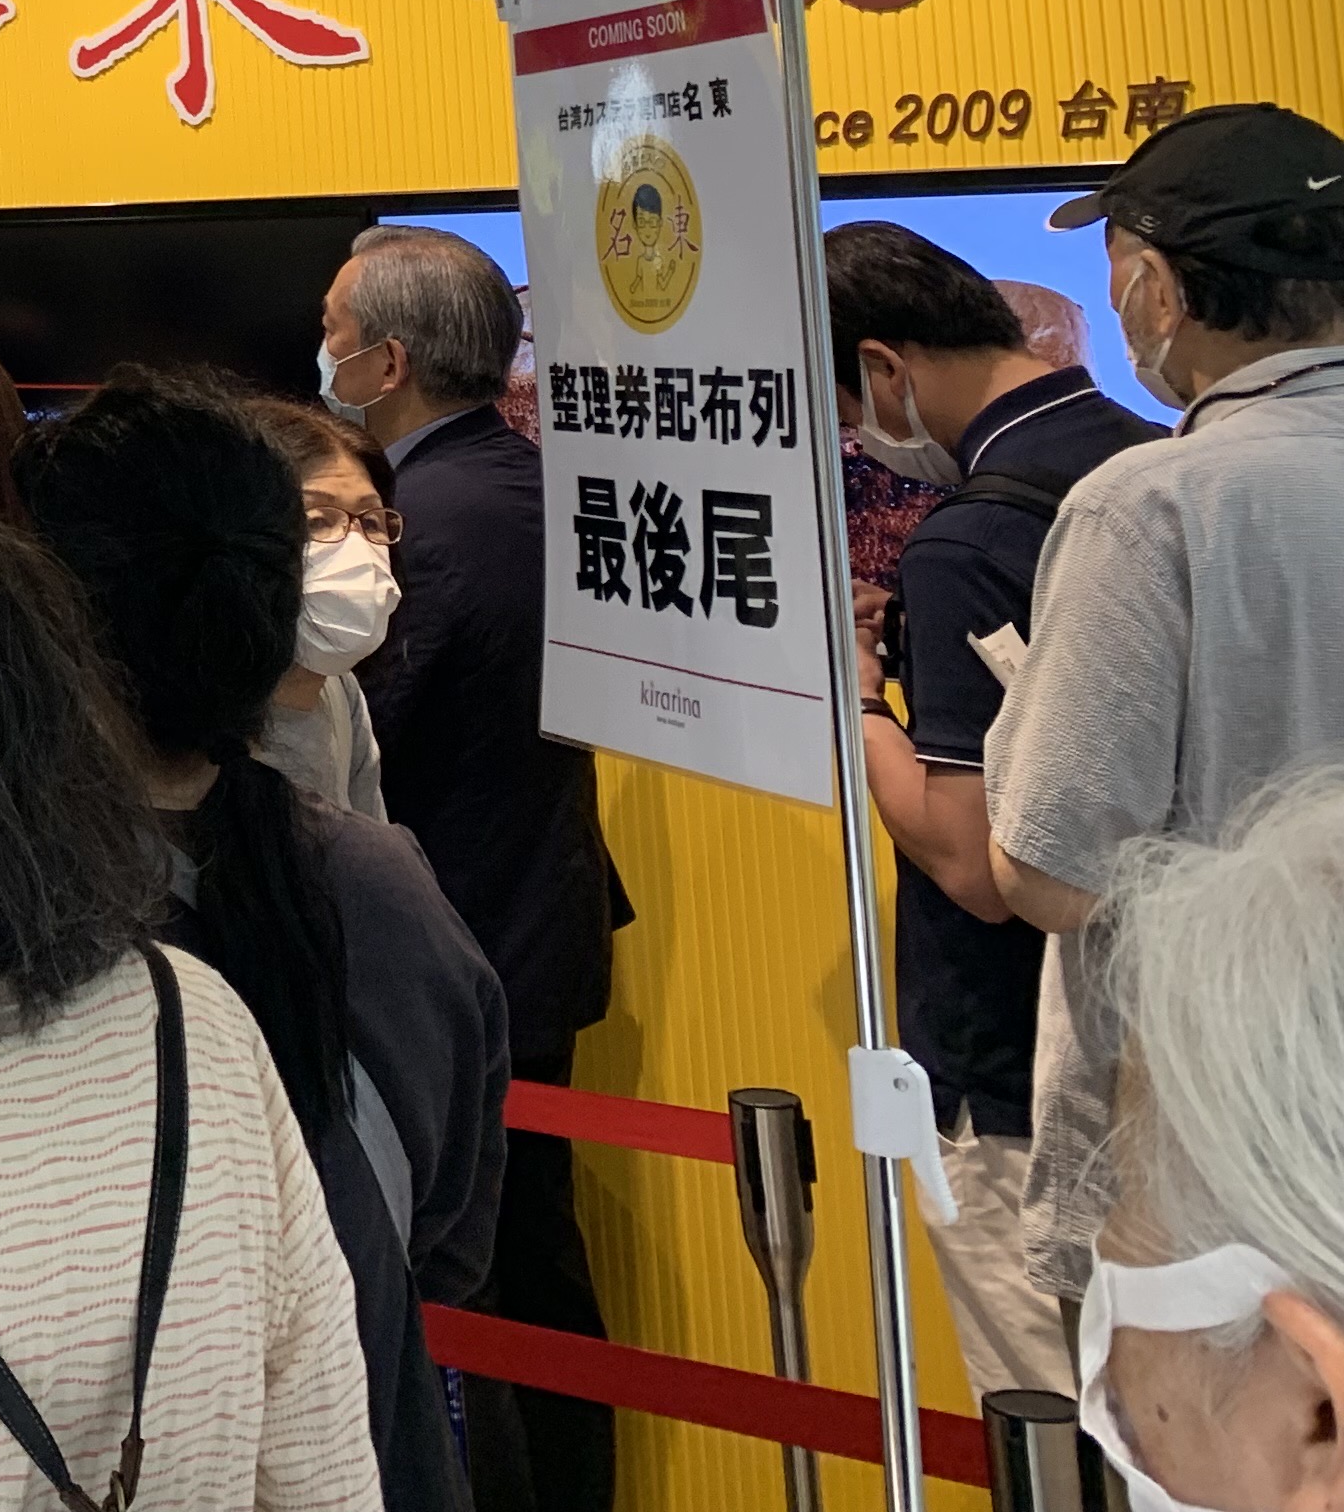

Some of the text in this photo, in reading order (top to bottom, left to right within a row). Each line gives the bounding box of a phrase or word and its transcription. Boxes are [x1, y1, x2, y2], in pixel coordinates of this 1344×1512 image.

[588, 10, 686, 49] COMING SOON
[889, 89, 1031, 144] 2009
[1059, 76, 1194, 139] 台南
[601, 194, 700, 263] 名 東
[549, 362, 798, 449] 整理券配布列
[573, 475, 779, 628] 最後尾
[641, 680, 701, 719] kirarina
